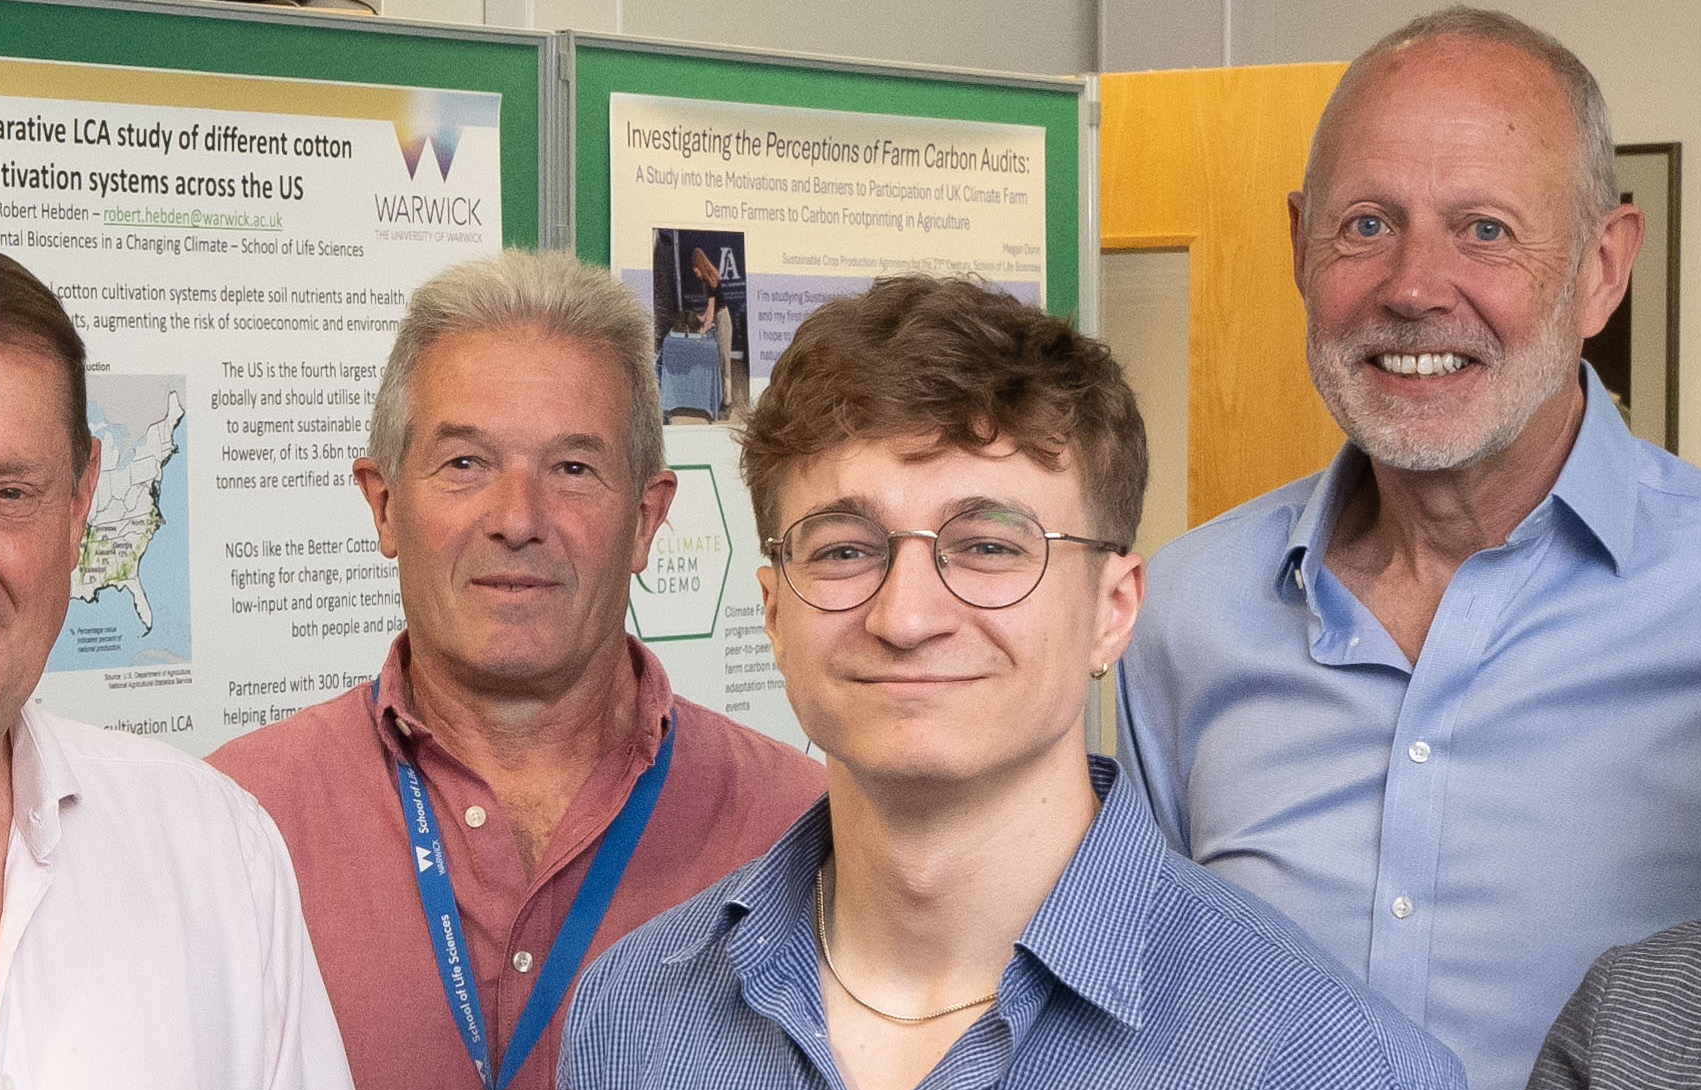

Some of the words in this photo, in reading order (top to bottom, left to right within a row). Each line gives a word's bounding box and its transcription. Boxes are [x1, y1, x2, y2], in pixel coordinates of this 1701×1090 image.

[74, 118, 111, 146] LCA
[118, 122, 173, 155] study
[179, 124, 199, 150] of
[204, 125, 287, 155] different
[294, 135, 351, 158] cotton
[627, 121, 734, 162] Investigating
[735, 129, 761, 156] the
[766, 131, 859, 166] Perceptions
[863, 139, 879, 164] of
[882, 141, 920, 167] Farm
[924, 143, 977, 170] Carbon
[980, 147, 1029, 174] Audits:
[89, 169, 169, 198] systems
[176, 176, 235, 197] across
[241, 172, 273, 199] the
[280, 175, 303, 200] US
[41, 203, 89, 221] Hebden
[104, 206, 284, 229] robert.hebden@warwick.ac.uk
[374, 194, 482, 226] WARWICK
[705, 199, 739, 220] Demo
[741, 201, 785, 222] Farmers
[788, 207, 799, 223] to
[801, 205, 839, 224] Carbon
[842, 207, 904, 232] Footprinting
[906, 215, 915, 228] in
[917, 211, 970, 233] Agriculture
[222, 362, 244, 378] The
[248, 362, 263, 378] US
[266, 362, 275, 378] is
[278, 362, 297, 378] the
[301, 361, 337, 378] fourth
[340, 362, 377, 382] largest
[656, 535, 721, 554] CLIMATE
[657, 557, 698, 574] FARM
[657, 576, 701, 594] DEMO
[410, 786, 421, 798] of
[413, 799, 429, 834] School
[441, 914, 459, 965] Sciences
[451, 966, 466, 989] Life
[455, 989, 468, 1002] of
[460, 1004, 481, 1043] School
